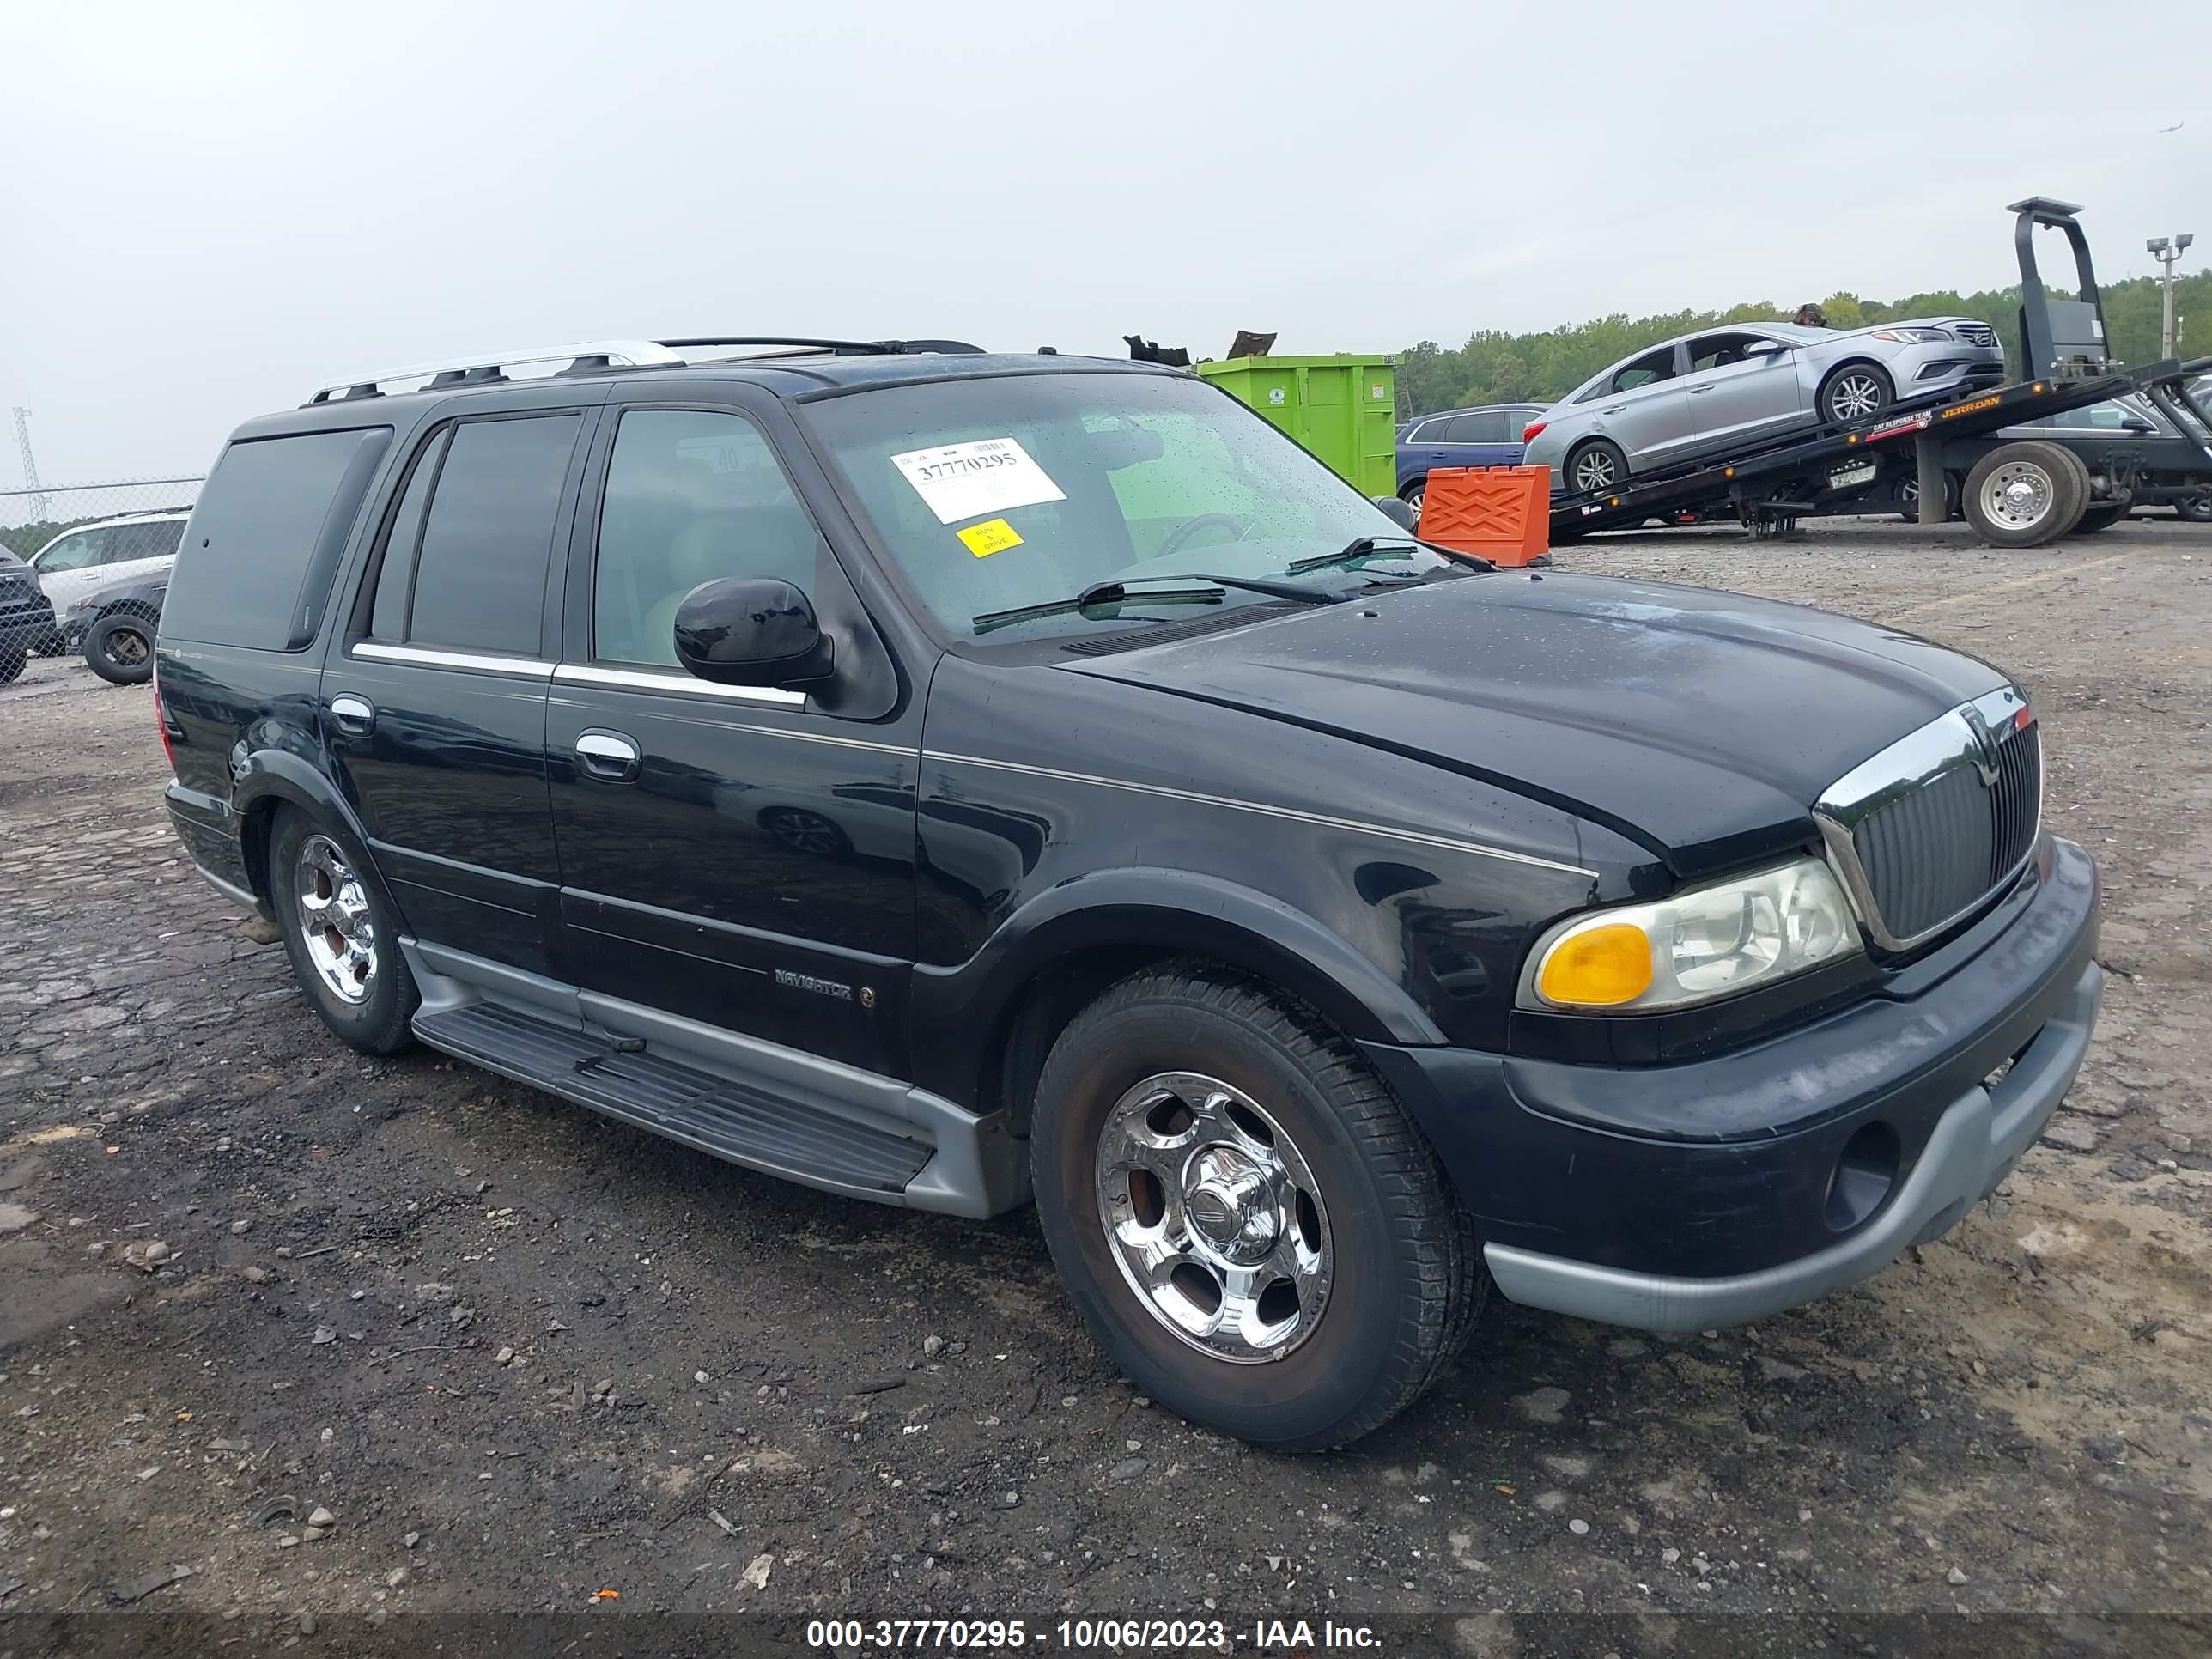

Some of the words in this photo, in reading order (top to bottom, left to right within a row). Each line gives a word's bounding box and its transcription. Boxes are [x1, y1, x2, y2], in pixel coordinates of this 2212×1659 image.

[1874, 422, 1885, 431] CAT
[1885, 415, 1913, 428] RESPONSE
[1914, 410, 1931, 420] TEAM
[917, 453, 1017, 481] 37770295
[983, 538, 1009, 550] DRIVE
[775, 969, 852, 1001] NAVIGATOR
